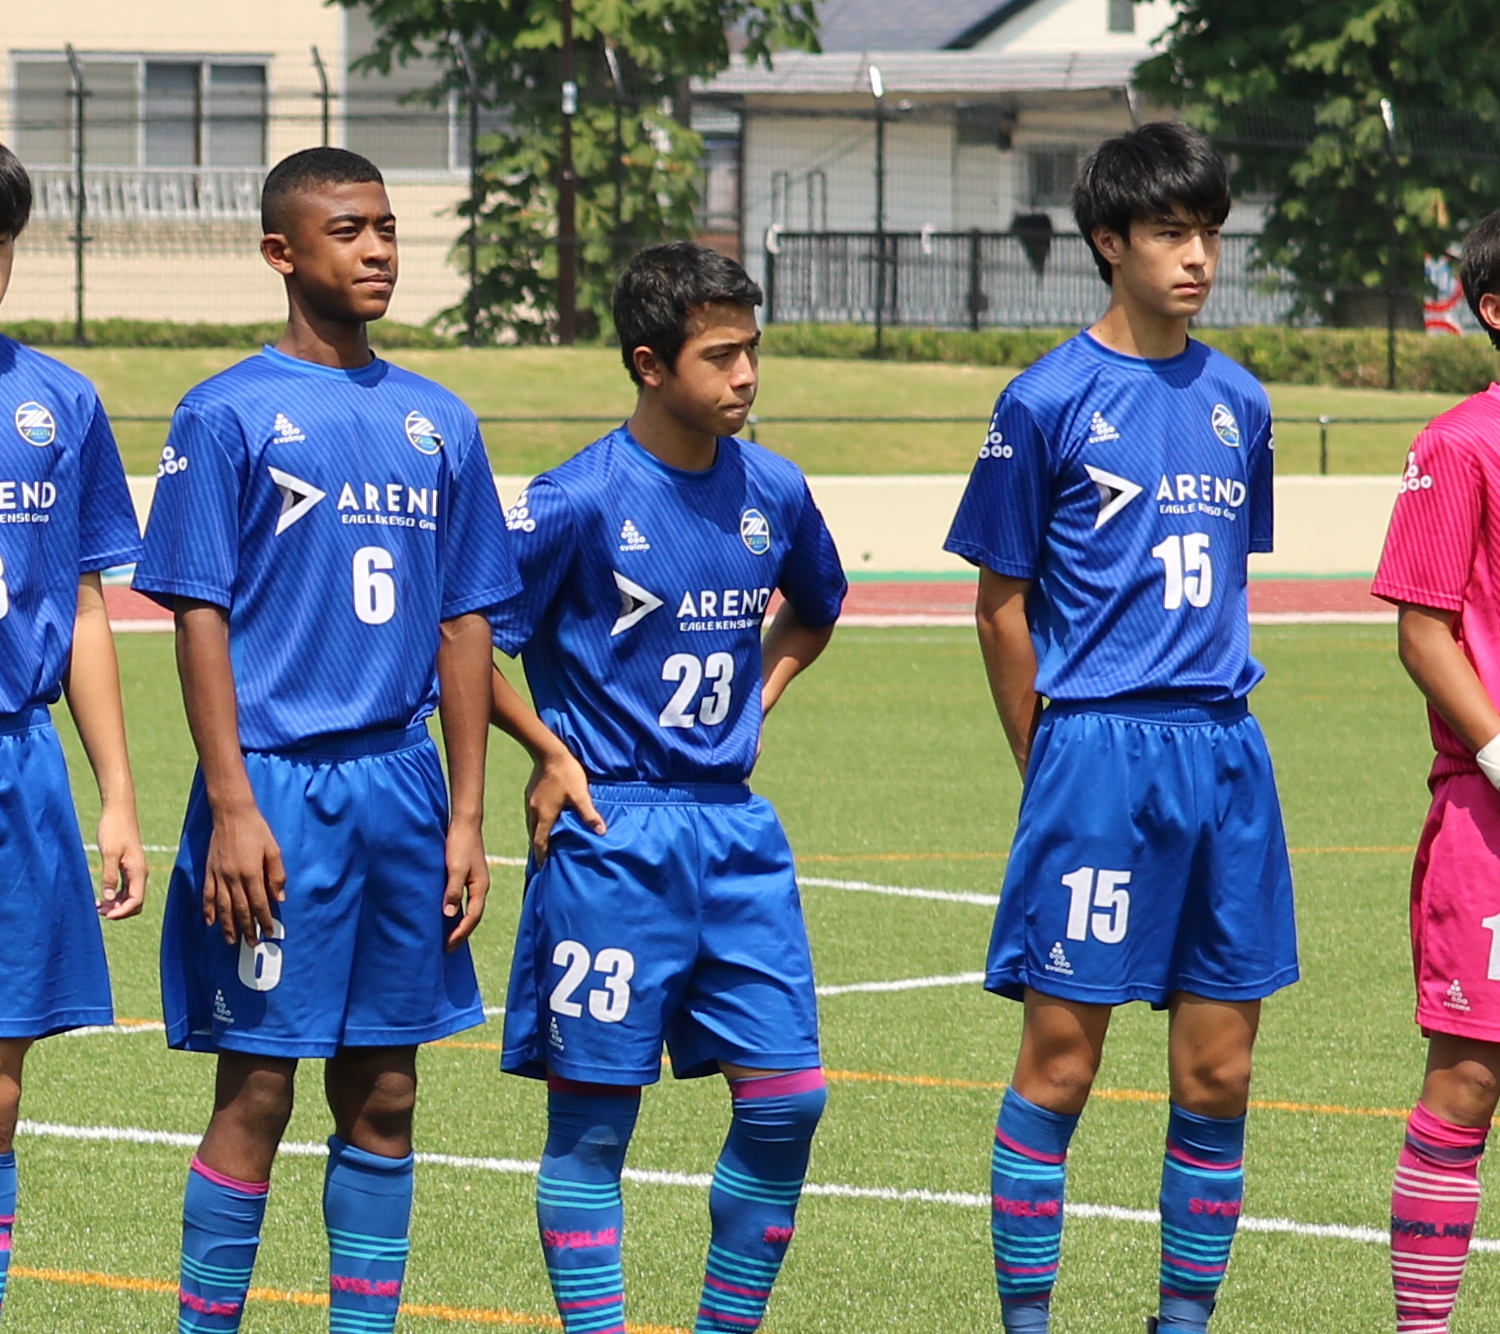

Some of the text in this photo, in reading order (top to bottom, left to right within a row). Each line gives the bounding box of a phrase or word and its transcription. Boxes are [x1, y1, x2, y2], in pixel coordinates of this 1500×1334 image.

[1156, 474, 1246, 507] AREND
[1160, 503, 1197, 515] EAGLE
[352, 546, 397, 625] 6
[676, 587, 771, 618] AREND
[1152, 532, 1213, 610] 15
[680, 620, 715, 632] EAGLE
[659, 651, 735, 729] 23
[1061, 867, 1132, 945] 15
[549, 939, 635, 1024] 23
